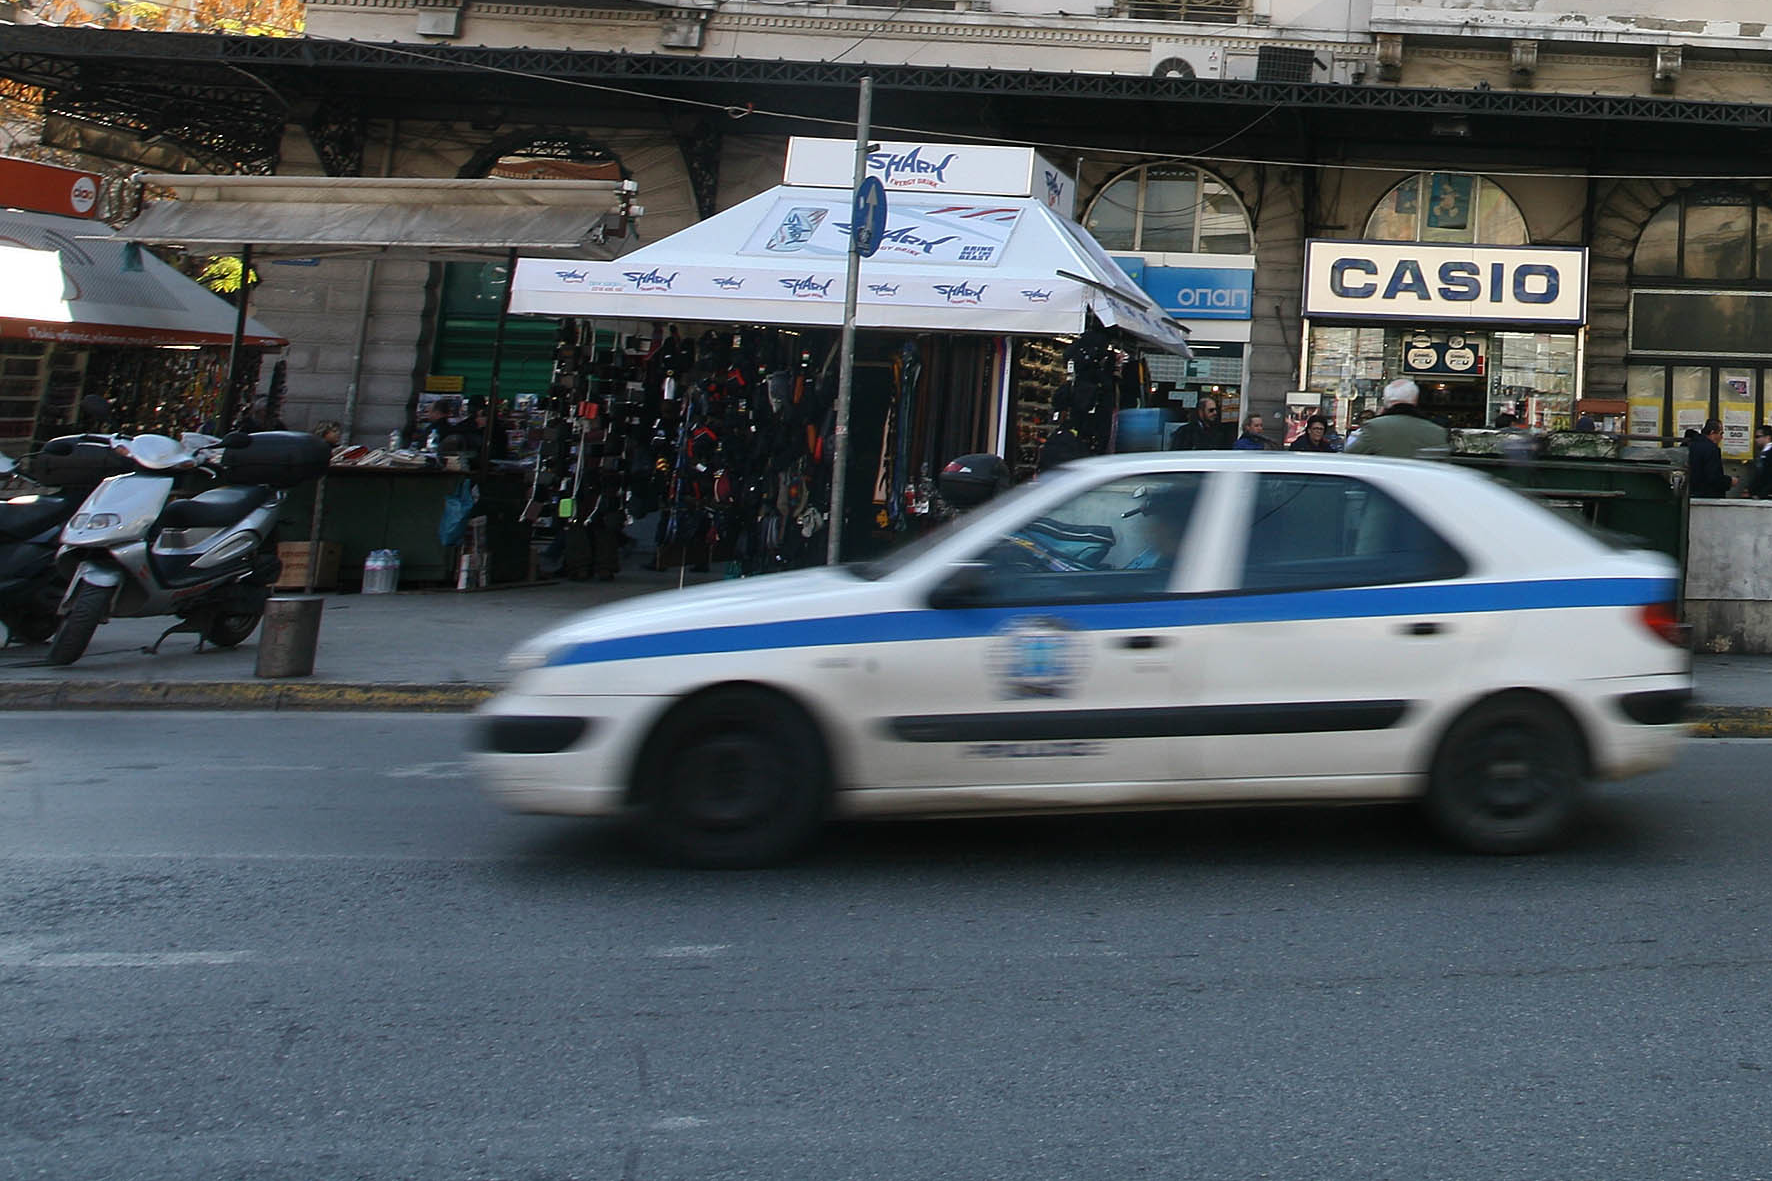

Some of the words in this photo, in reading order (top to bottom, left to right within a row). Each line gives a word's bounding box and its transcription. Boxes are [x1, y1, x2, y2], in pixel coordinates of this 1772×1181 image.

[866, 146, 957, 183] SHARK
[832, 222, 961, 254] SARK
[622, 268, 679, 289] SHARK
[778, 275, 836, 296] SHARK
[932, 280, 988, 301] SHARK
[1330, 257, 1560, 304] CASIO
